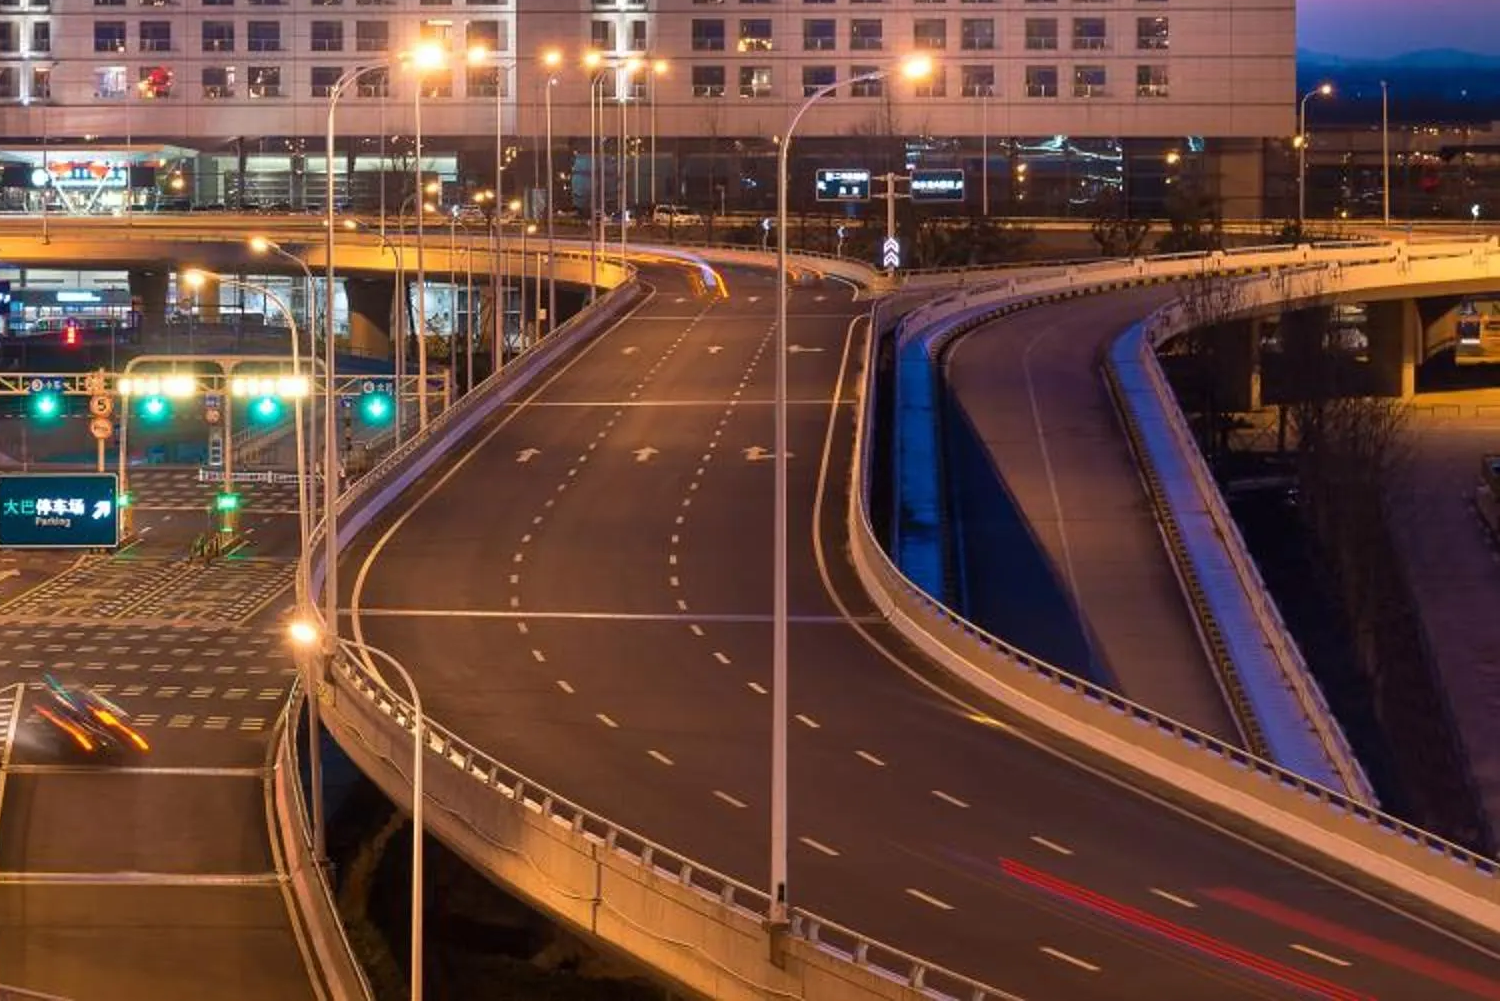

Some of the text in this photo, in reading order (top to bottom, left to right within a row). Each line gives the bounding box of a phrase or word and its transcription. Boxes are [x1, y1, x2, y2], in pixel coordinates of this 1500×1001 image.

[3, 499, 85, 515] 大巴停车场
